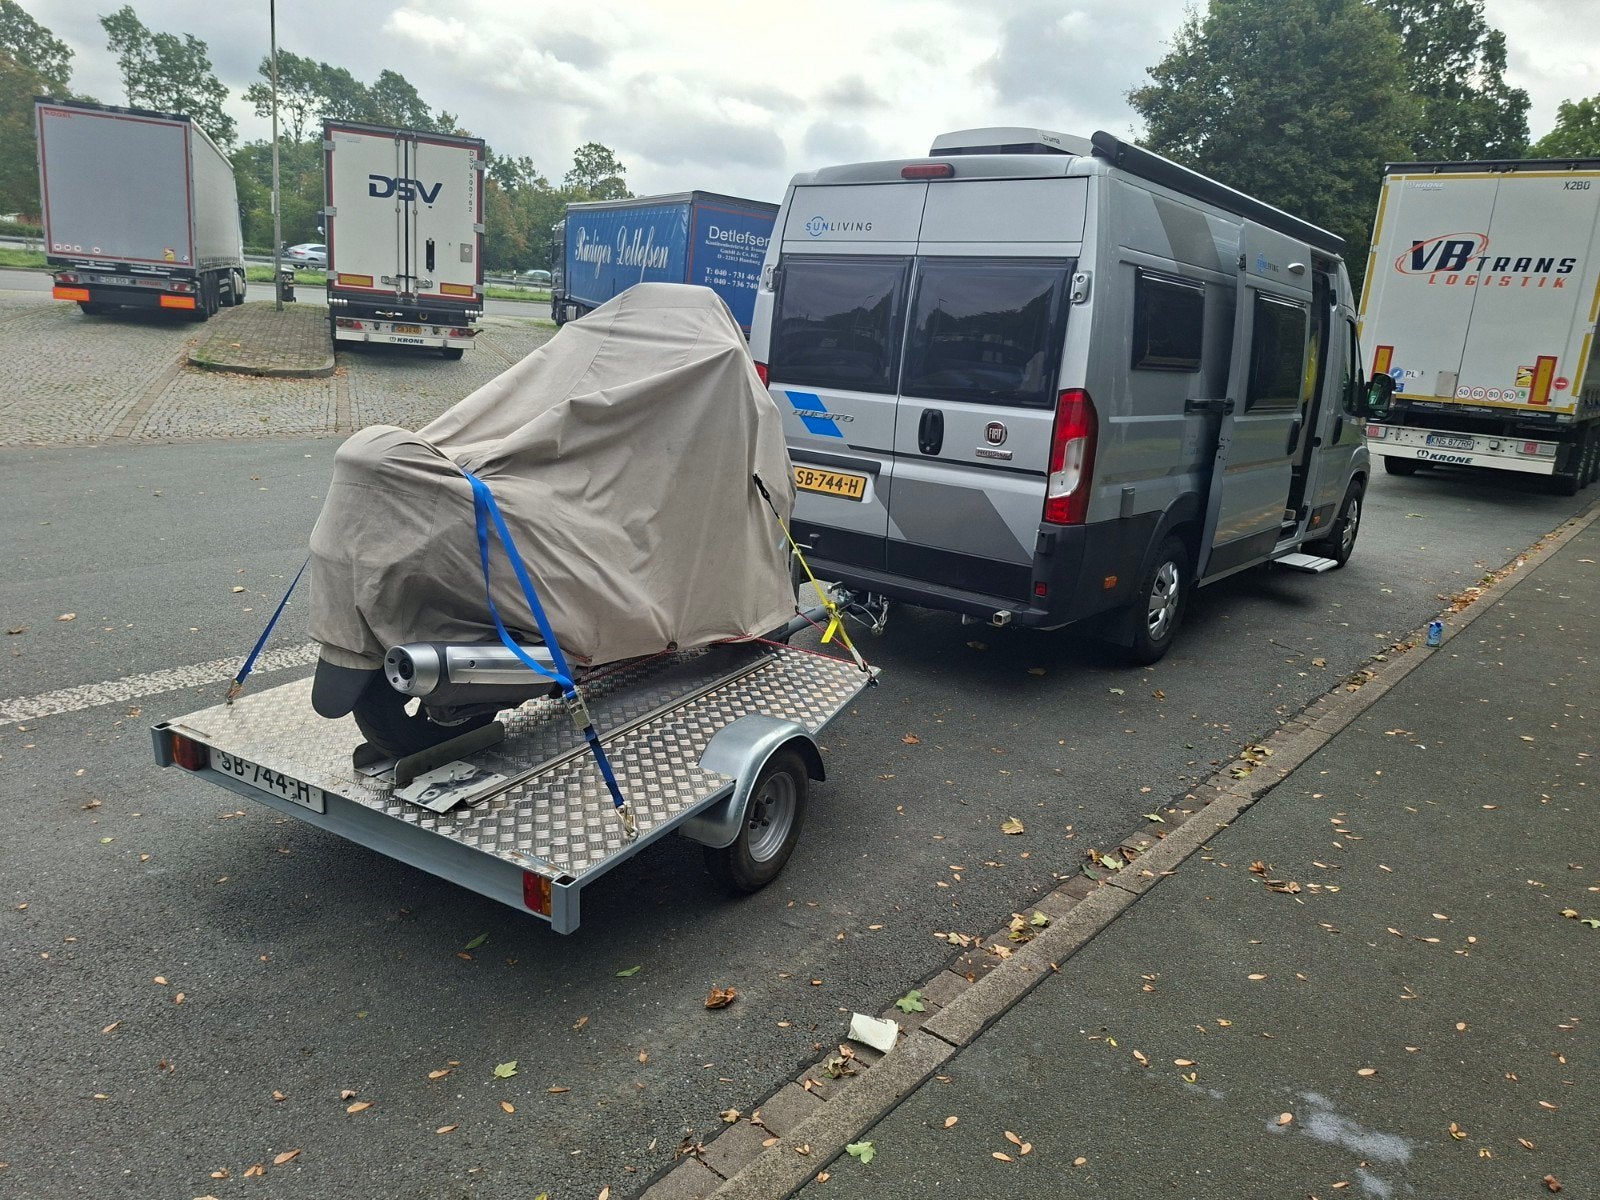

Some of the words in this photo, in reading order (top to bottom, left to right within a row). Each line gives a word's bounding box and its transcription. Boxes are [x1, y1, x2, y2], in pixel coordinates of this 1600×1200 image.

[368, 174, 443, 204] DSV
[1411, 240, 1475, 272] VB
[1476, 256, 1577, 274] TRANS
[1428, 273, 1568, 289] LOGISTIK
[1458, 388, 1469, 396] 50
[1503, 392, 1514, 400] 90
[988, 427, 1003, 440] FIAT
[1429, 453, 1474, 465] KRONE
[796, 470, 859, 494] SB-744-H
